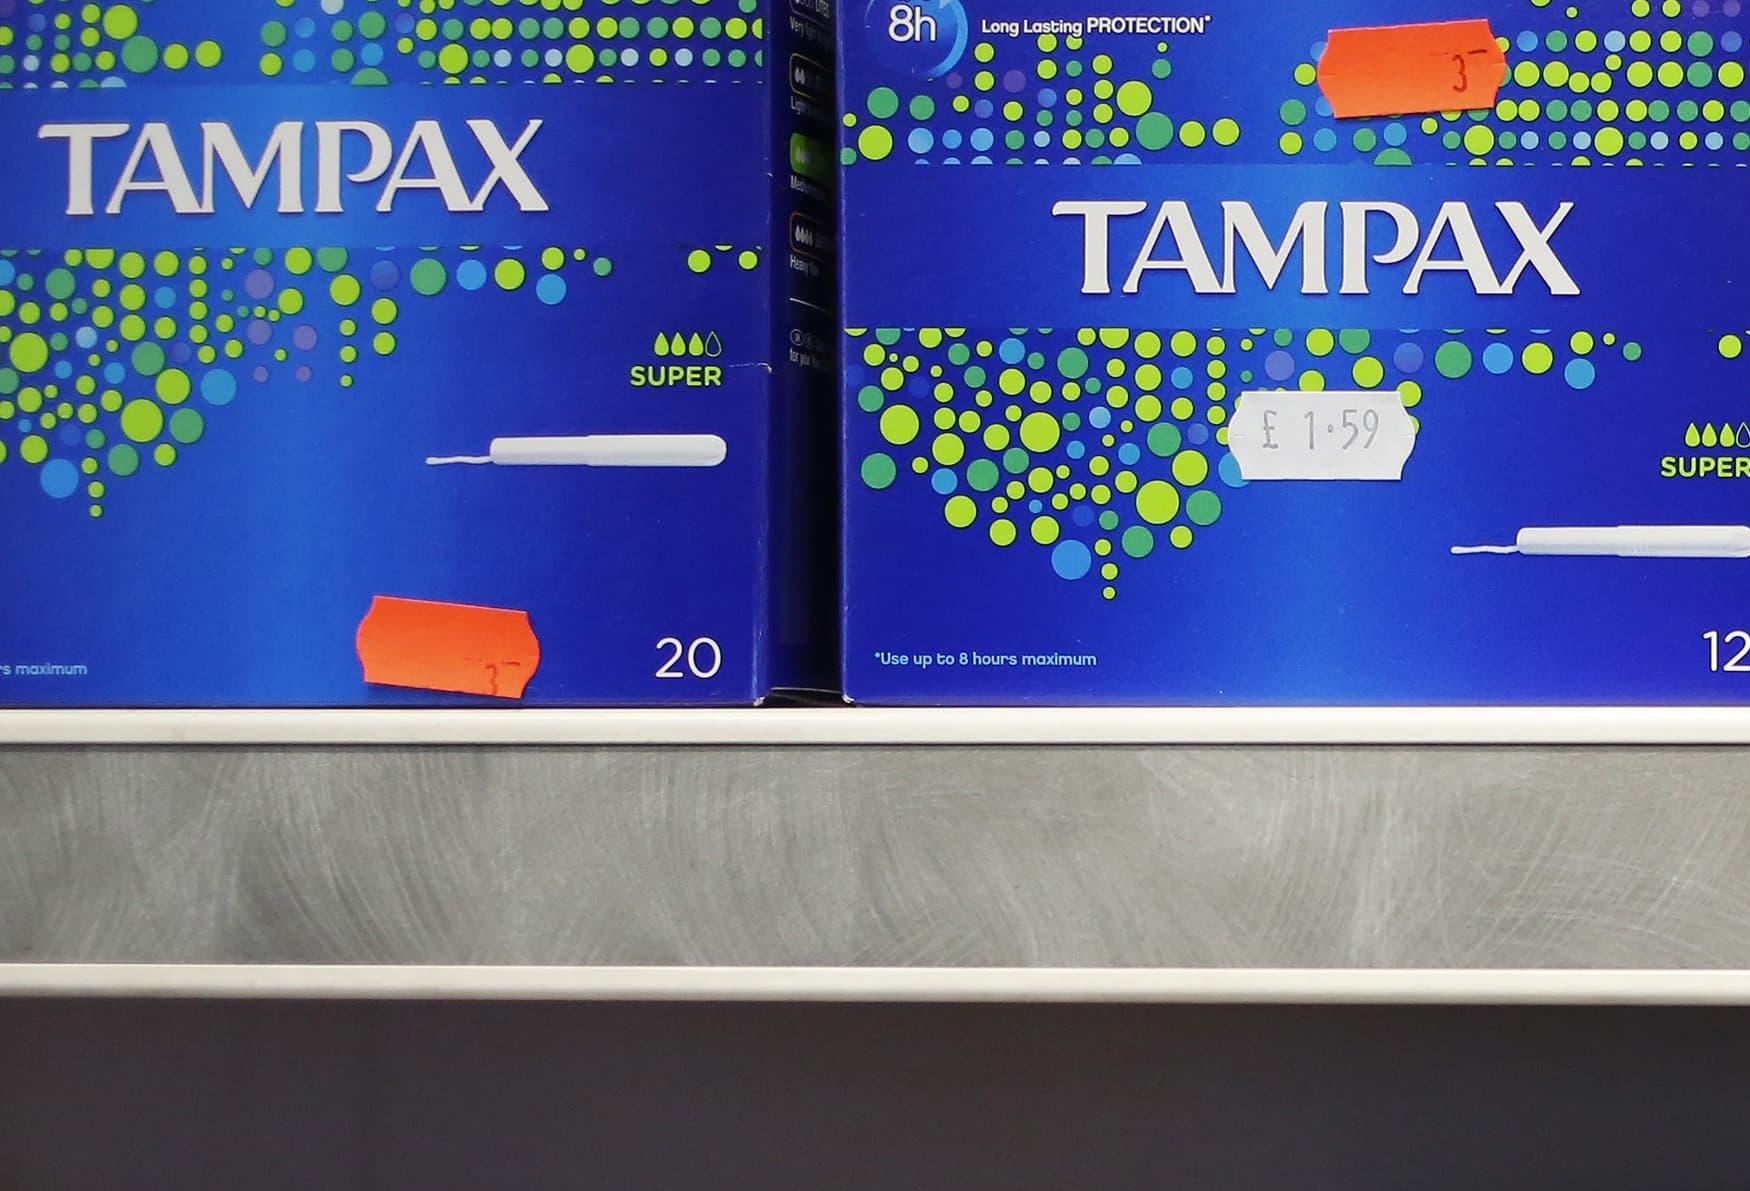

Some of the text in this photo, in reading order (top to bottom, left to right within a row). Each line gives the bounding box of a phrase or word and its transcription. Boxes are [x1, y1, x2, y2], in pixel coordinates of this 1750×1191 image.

[887, 4, 937, 42] 8h
[981, 18, 1021, 36] Long
[1023, 18, 1083, 36] Lasting
[38, 118, 551, 216] TAMPAX
[1052, 200, 1581, 294] TAMPAX
[629, 365, 722, 387] SUPER
[1262, 409, 1279, 450] £
[15, 662, 88, 676] maximum
[654, 637, 722, 679] 20
[913, 655, 932, 669] up
[937, 653, 954, 665] to
[959, 652, 968, 665] 8
[973, 652, 1018, 665] hours
[1022, 652, 1097, 665] maximum
